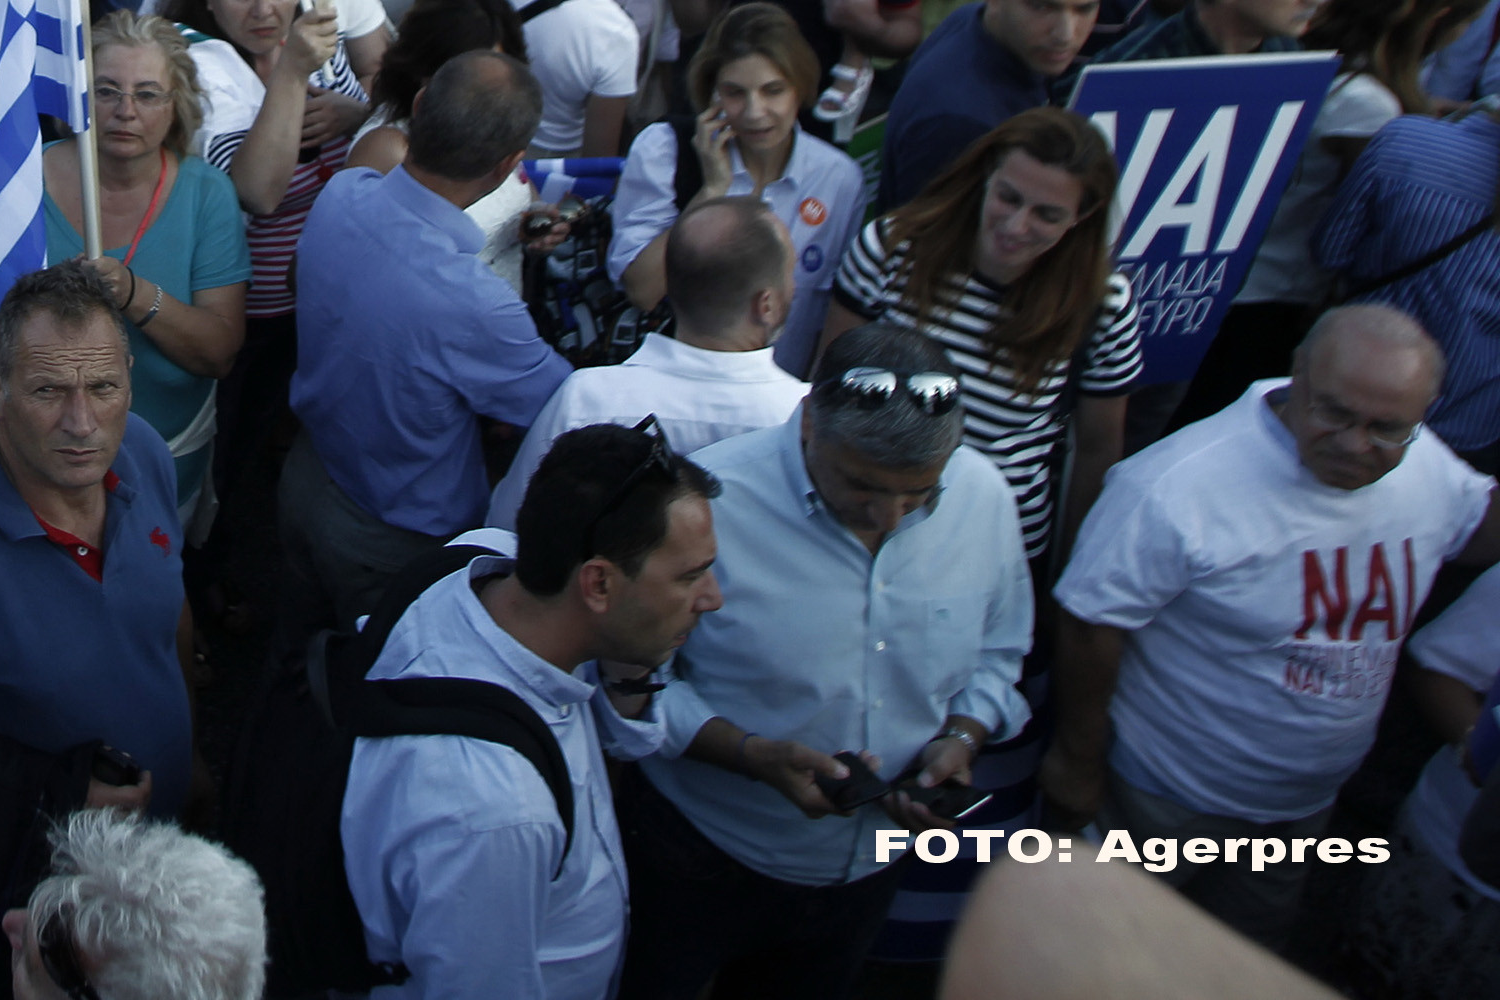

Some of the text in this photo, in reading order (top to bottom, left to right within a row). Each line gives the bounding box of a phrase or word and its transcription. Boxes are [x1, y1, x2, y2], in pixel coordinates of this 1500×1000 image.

[1116, 256, 1230, 300] ΛΛΑΔΑ
[1293, 537, 1414, 643] ΝΑΙ
[1284, 661, 1325, 695] ΝΑΙ
